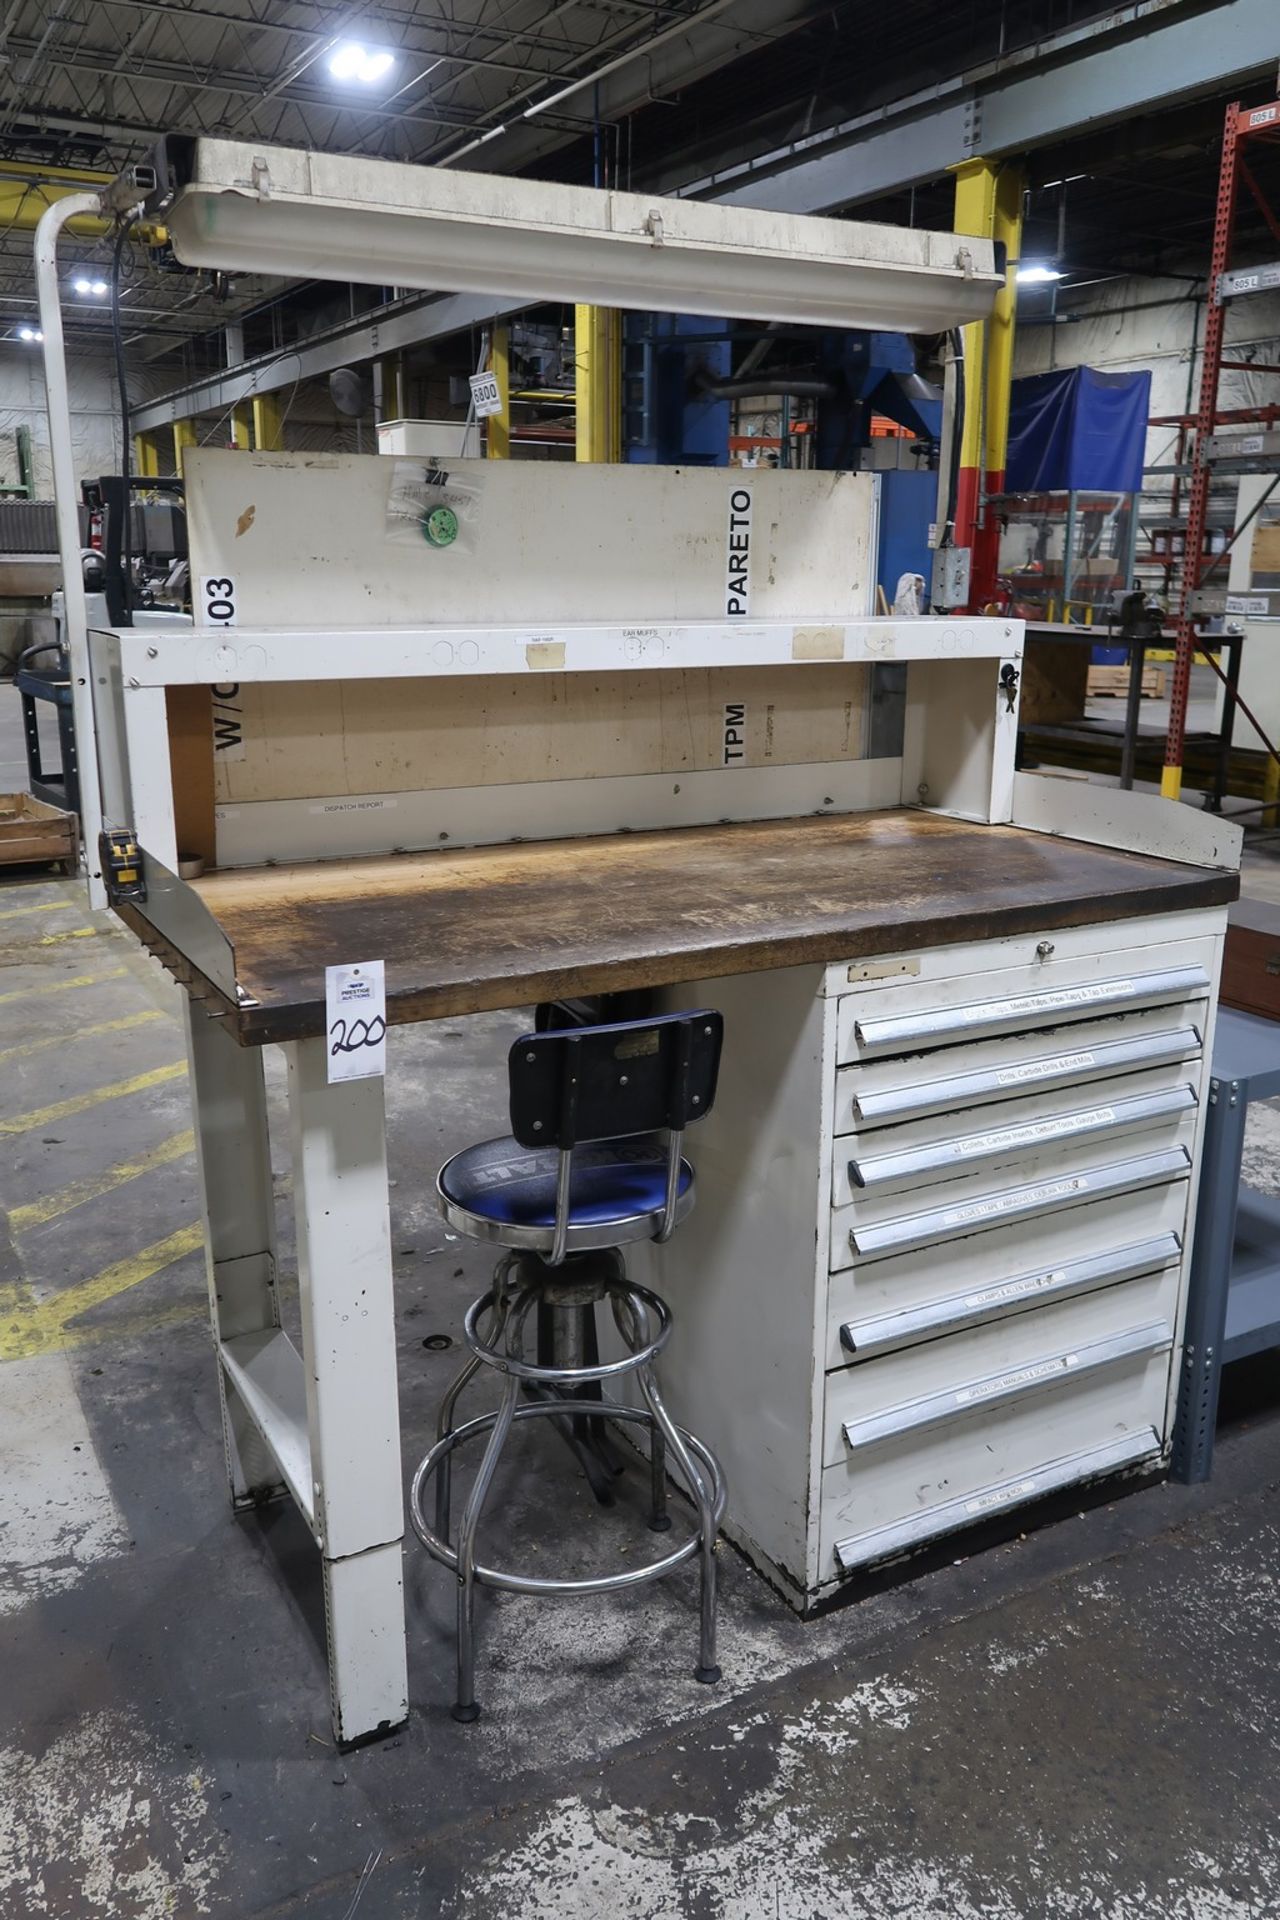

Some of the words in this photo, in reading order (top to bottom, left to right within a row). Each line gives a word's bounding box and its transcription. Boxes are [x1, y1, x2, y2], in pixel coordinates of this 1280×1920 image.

[474, 383, 497, 403] 6800
[727, 490, 751, 615] PARETO
[206, 578, 235, 626] 03
[724, 704, 745, 764] TPM
[324, 803, 356, 812] DISPATCH
[357, 801, 384, 809] REPORT
[341, 987, 370, 996] PRESTIGE
[342, 993, 370, 1001] AUCTIONS
[330, 1014, 386, 1056] 200
